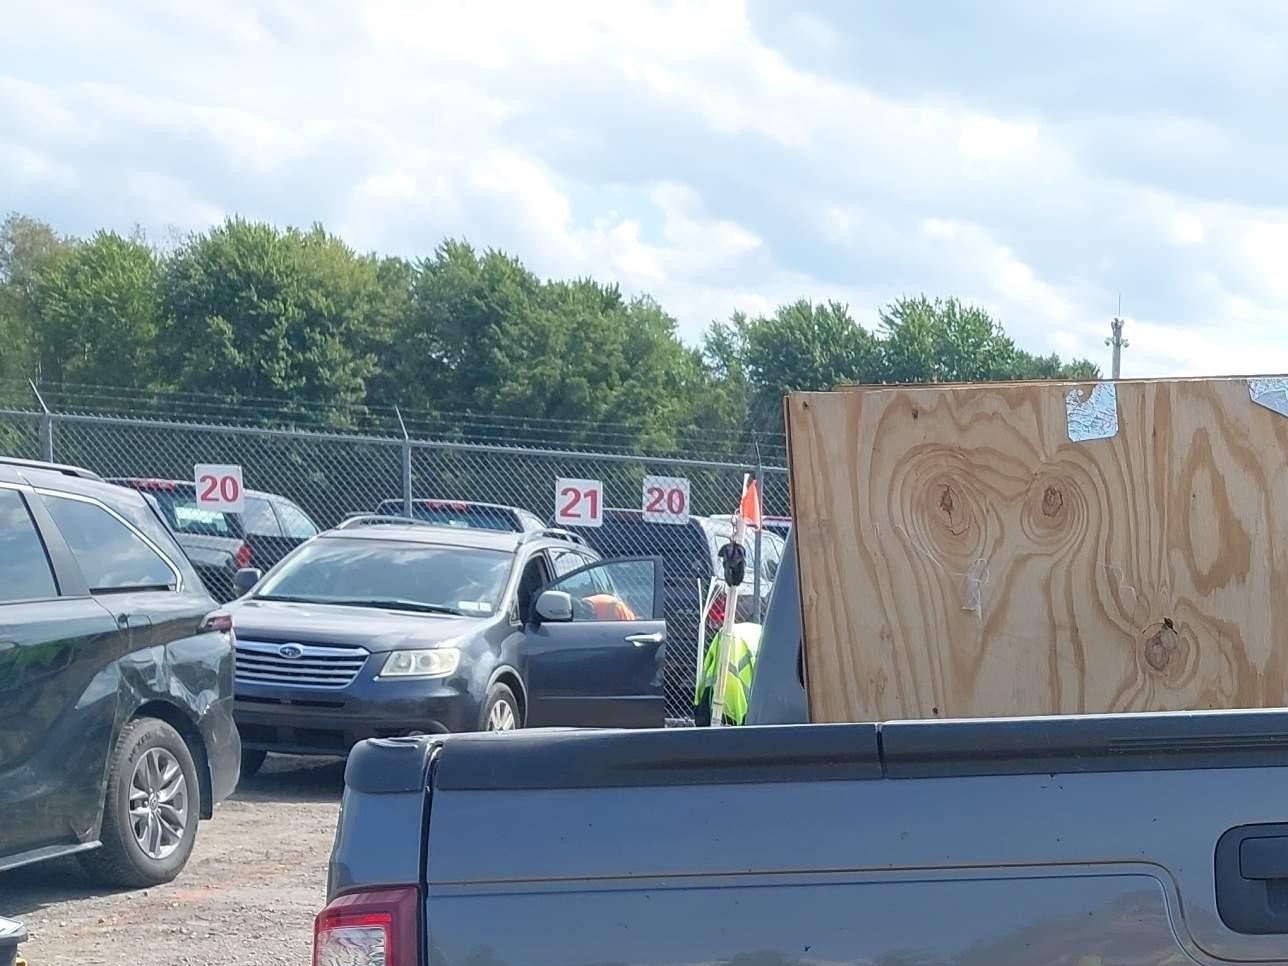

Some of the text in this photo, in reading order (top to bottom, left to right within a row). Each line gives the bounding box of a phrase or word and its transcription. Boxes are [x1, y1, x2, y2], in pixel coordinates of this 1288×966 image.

[199, 475, 240, 503] 20
[645, 487, 686, 515] 20
[559, 487, 599, 520] 21
